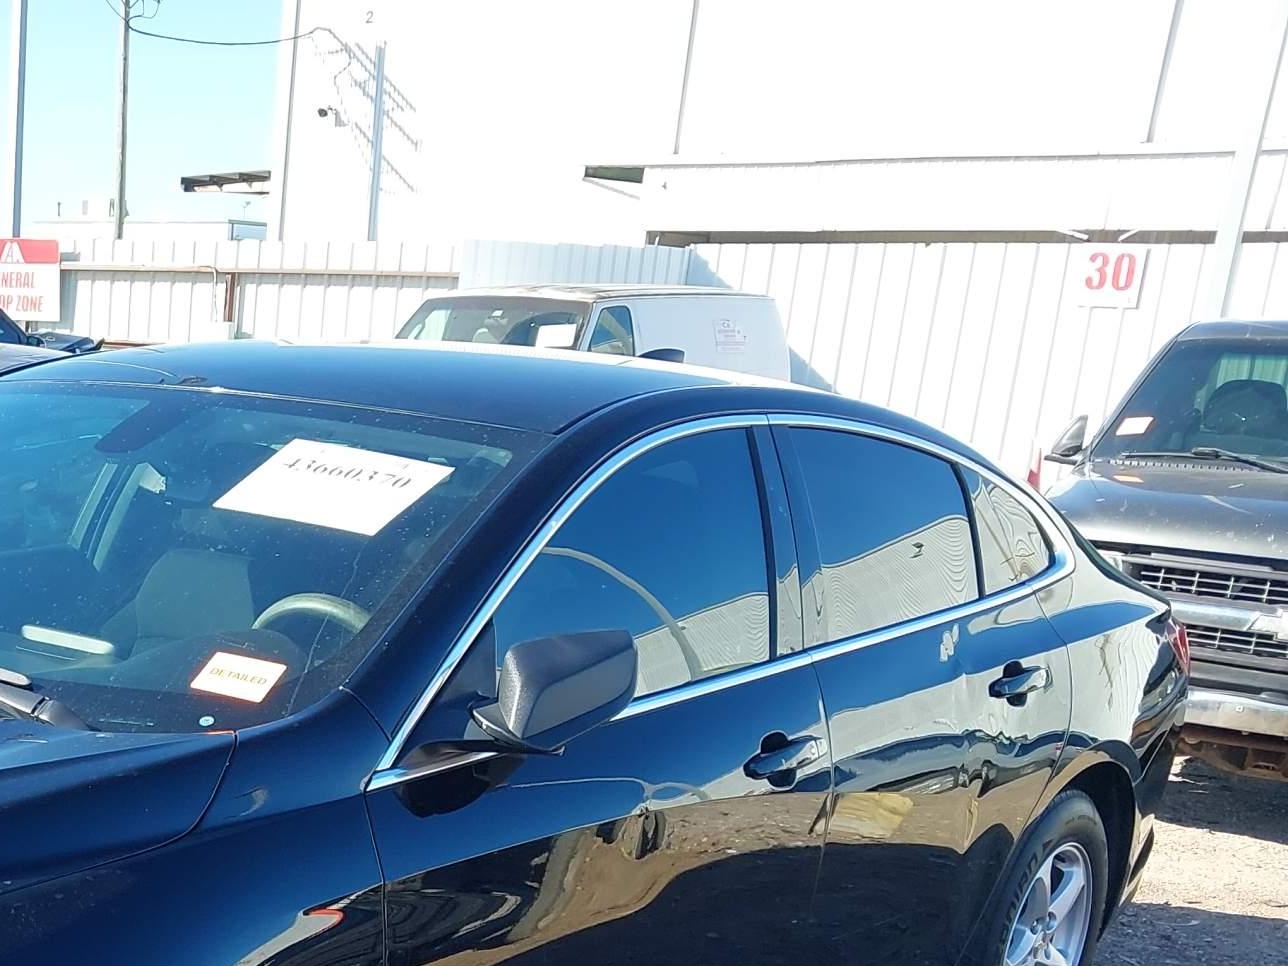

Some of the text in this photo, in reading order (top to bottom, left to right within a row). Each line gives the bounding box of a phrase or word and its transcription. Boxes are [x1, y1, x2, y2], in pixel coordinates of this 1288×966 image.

[365, 10, 374, 24] 2
[1085, 252, 1137, 291] 30
[15, 295, 44, 312] ZONE
[283, 458, 412, 489] 43660370
[210, 667, 268, 686] DETAILED
